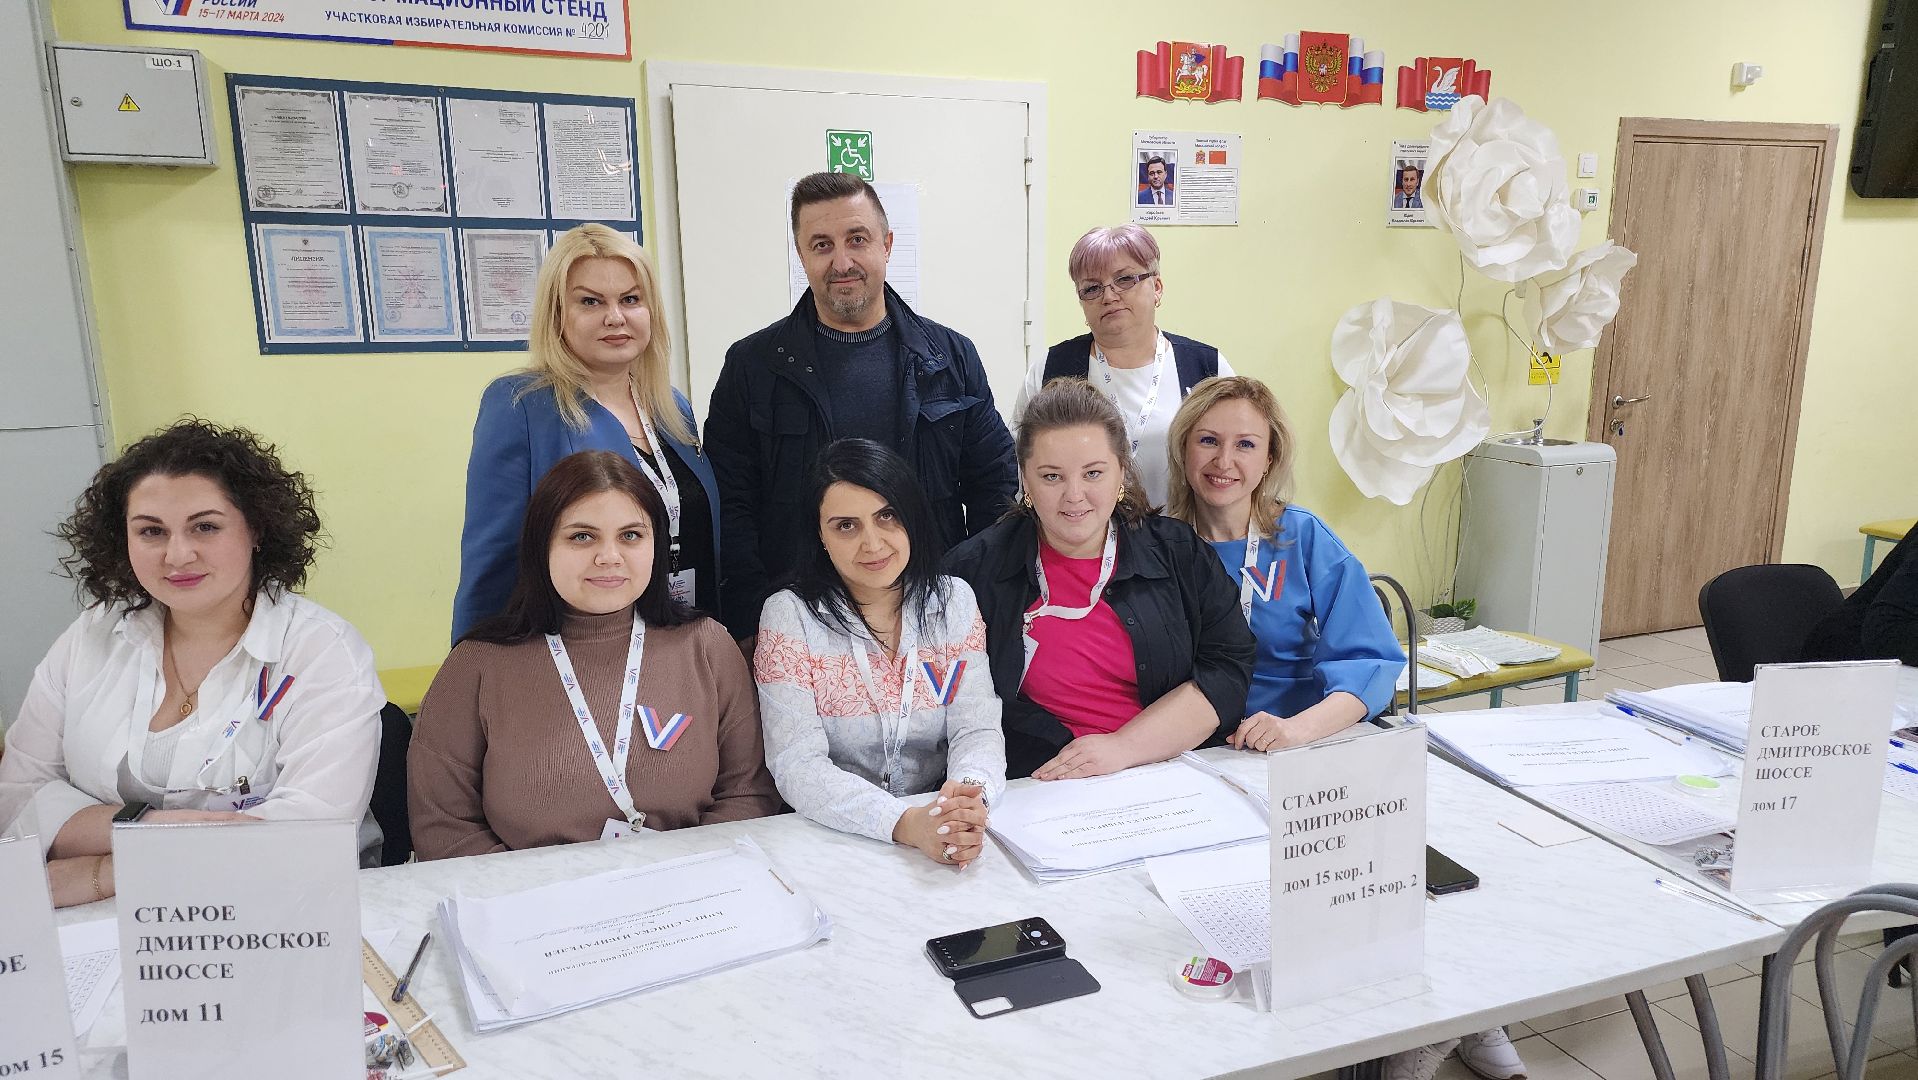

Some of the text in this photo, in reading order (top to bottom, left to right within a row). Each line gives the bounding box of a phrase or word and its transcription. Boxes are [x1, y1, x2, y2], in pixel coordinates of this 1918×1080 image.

[227, 10, 260, 21] МАРТА
[262, 12, 285, 23] 2024
[542, 0, 608, 22] СТЕНД
[325, 10, 402, 25] УЧАСТКОВАЯ
[406, 17, 501, 32] ИЗБИРАТЕЛЬНАЯ
[504, 23, 563, 37] КОМИССИЯ
[566, 28, 576, 37] №
[1761, 725, 1821, 738] СТАРОЕ
[1757, 743, 1872, 761] ДМИТРОВСКОЕ
[1756, 767, 1813, 779] ШОССЕ
[1282, 785, 1349, 811] СТАРОЕ
[1751, 796, 1797, 812] дом 17
[1282, 797, 1408, 838] ДМИТРОВСКОЕ
[1283, 834, 1346, 860] ШОССЕ
[1282, 860, 1374, 895] дом 15 кор. 1
[1329, 874, 1417, 908] дом 15 кор. 2
[135, 905, 236, 923] СТАРОЕ
[136, 932, 331, 956] ДМИТРОВСКОЕ
[139, 963, 234, 980] ШОССЕ
[140, 1003, 224, 1024] дом 11
[39, 1048, 65, 1069] 15
